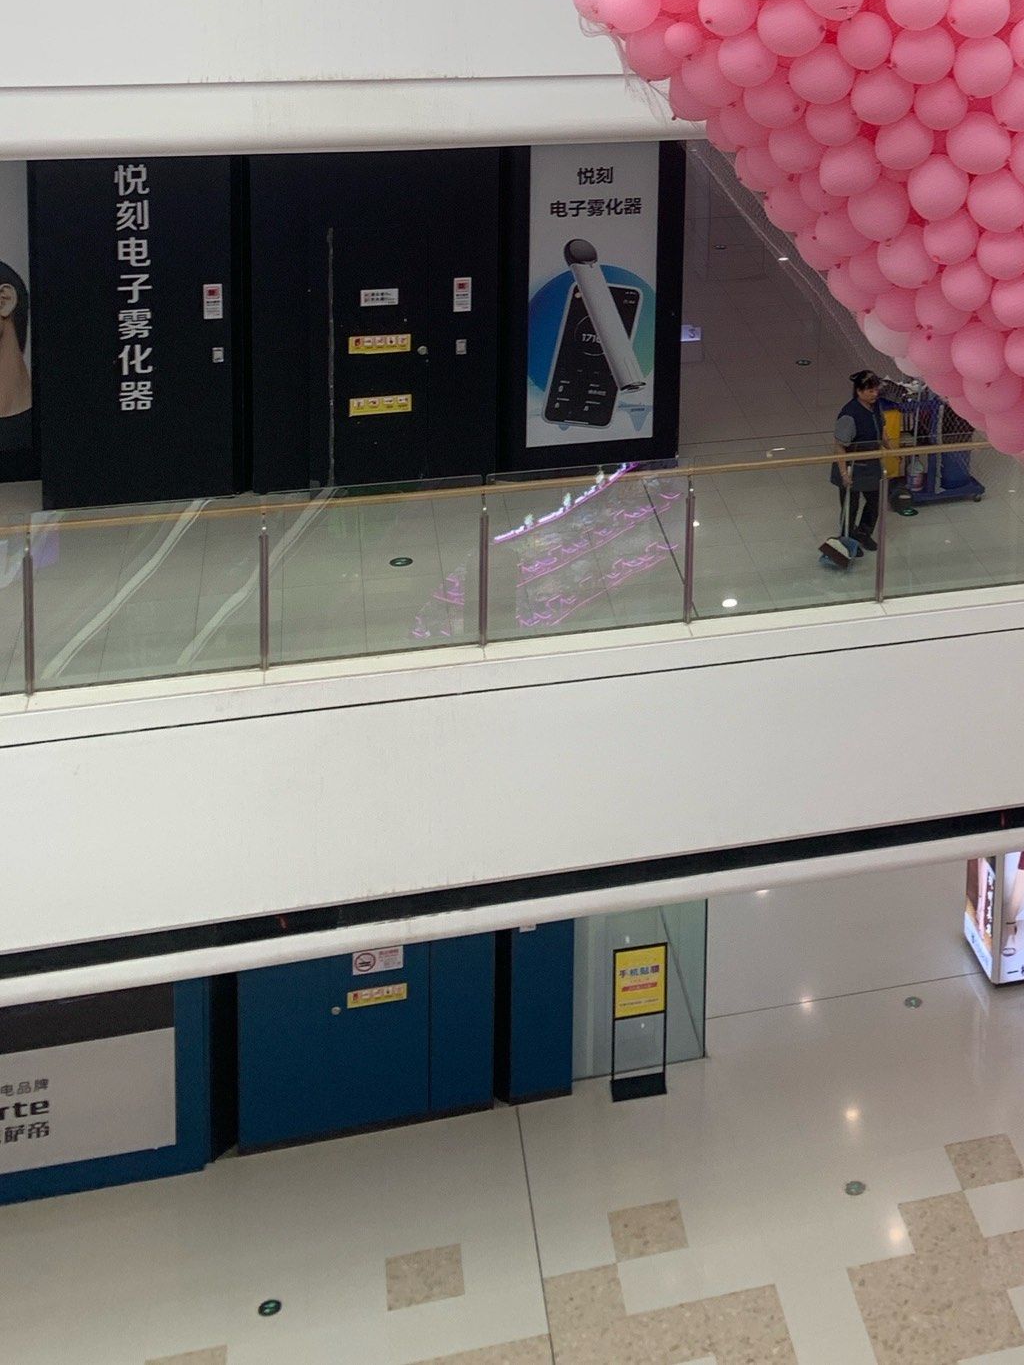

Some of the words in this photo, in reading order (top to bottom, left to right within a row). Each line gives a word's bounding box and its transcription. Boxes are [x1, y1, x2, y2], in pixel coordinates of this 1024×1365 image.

[576, 166, 614, 186] 悦刻
[549, 197, 642, 218] 电子雾化器
[113, 164, 154, 411] 悦刻电子雾化器
[0, 1078, 49, 1096] 电品牌
[0, 1100, 50, 1121] rte
